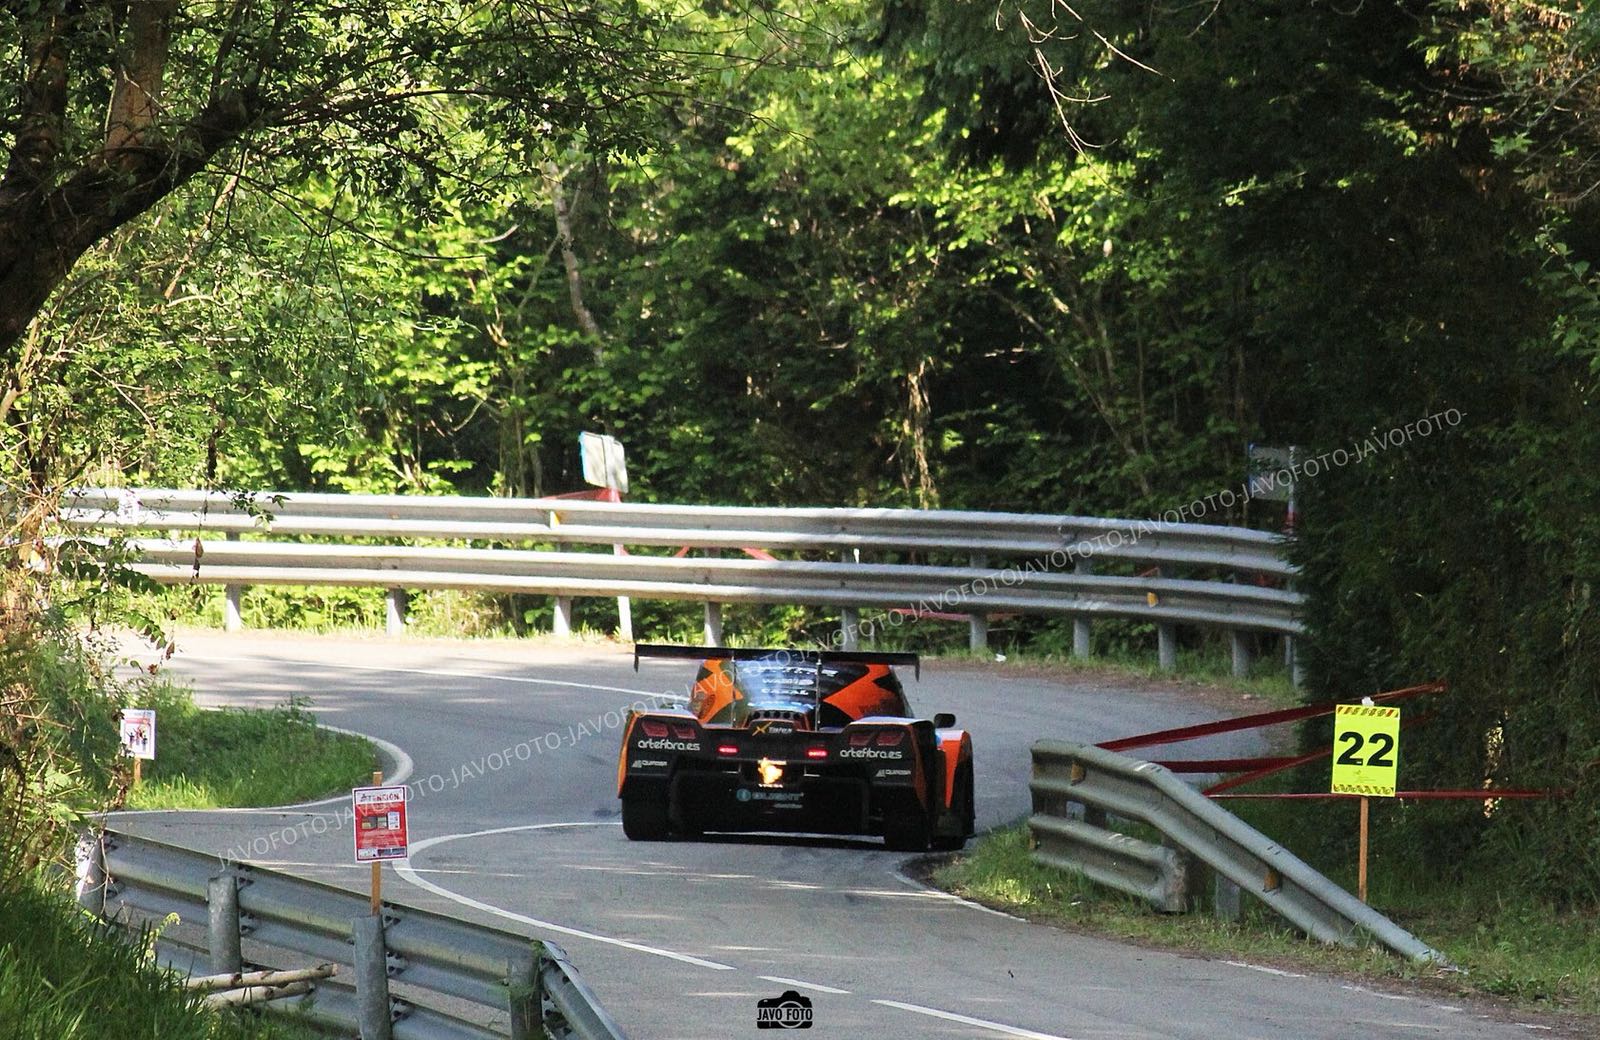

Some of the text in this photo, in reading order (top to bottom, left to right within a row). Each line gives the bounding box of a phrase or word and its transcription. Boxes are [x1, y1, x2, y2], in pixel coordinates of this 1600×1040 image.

[637, 738, 701, 751] artefibra.es
[1336, 731, 1394, 767] 22
[839, 747, 902, 760] artefibra.es
